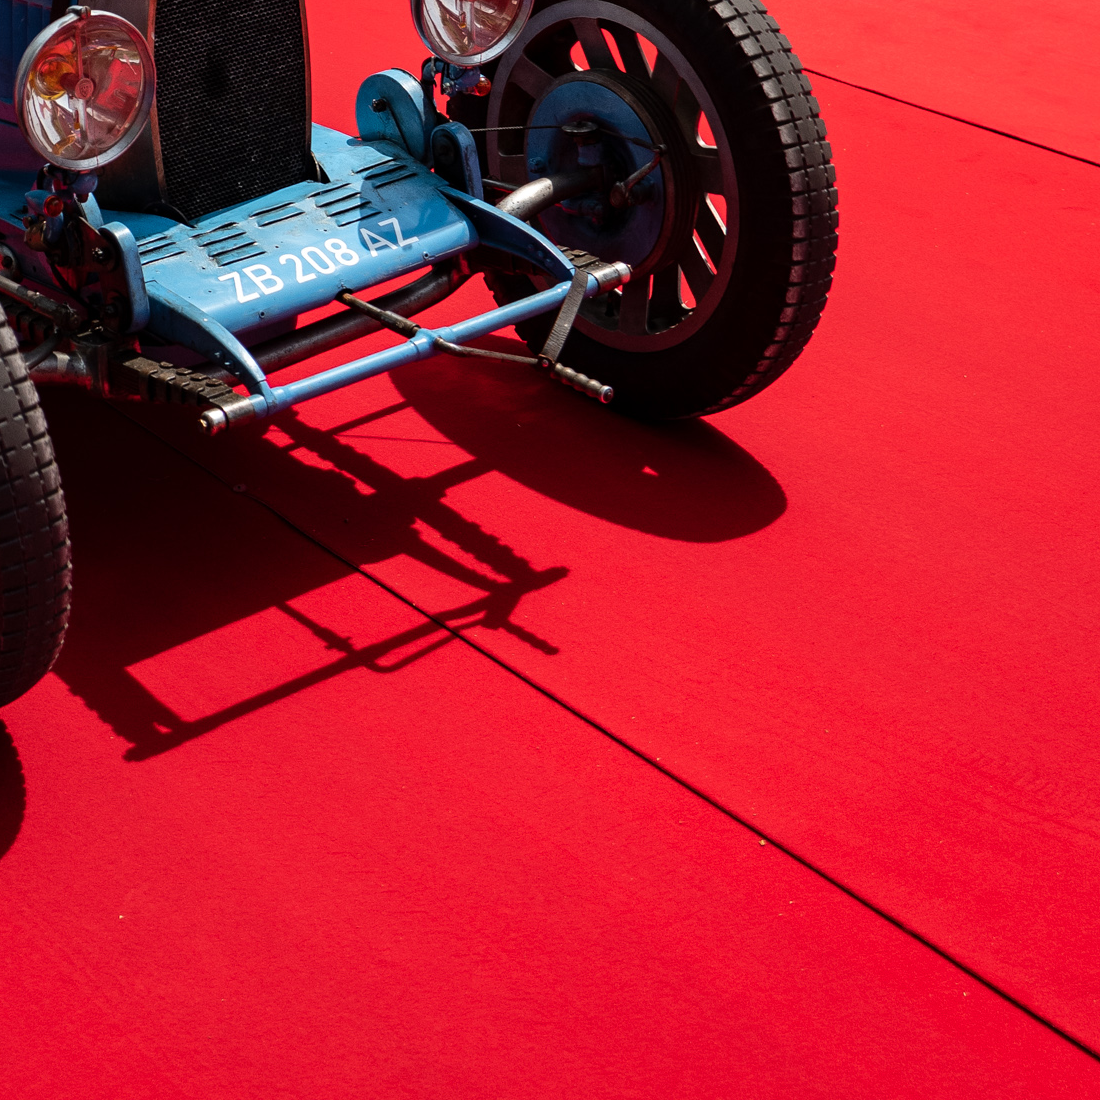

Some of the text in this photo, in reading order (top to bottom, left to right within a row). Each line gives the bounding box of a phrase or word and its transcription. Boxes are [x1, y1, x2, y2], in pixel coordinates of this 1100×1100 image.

[217, 217, 420, 304] ZB 208 AZ
